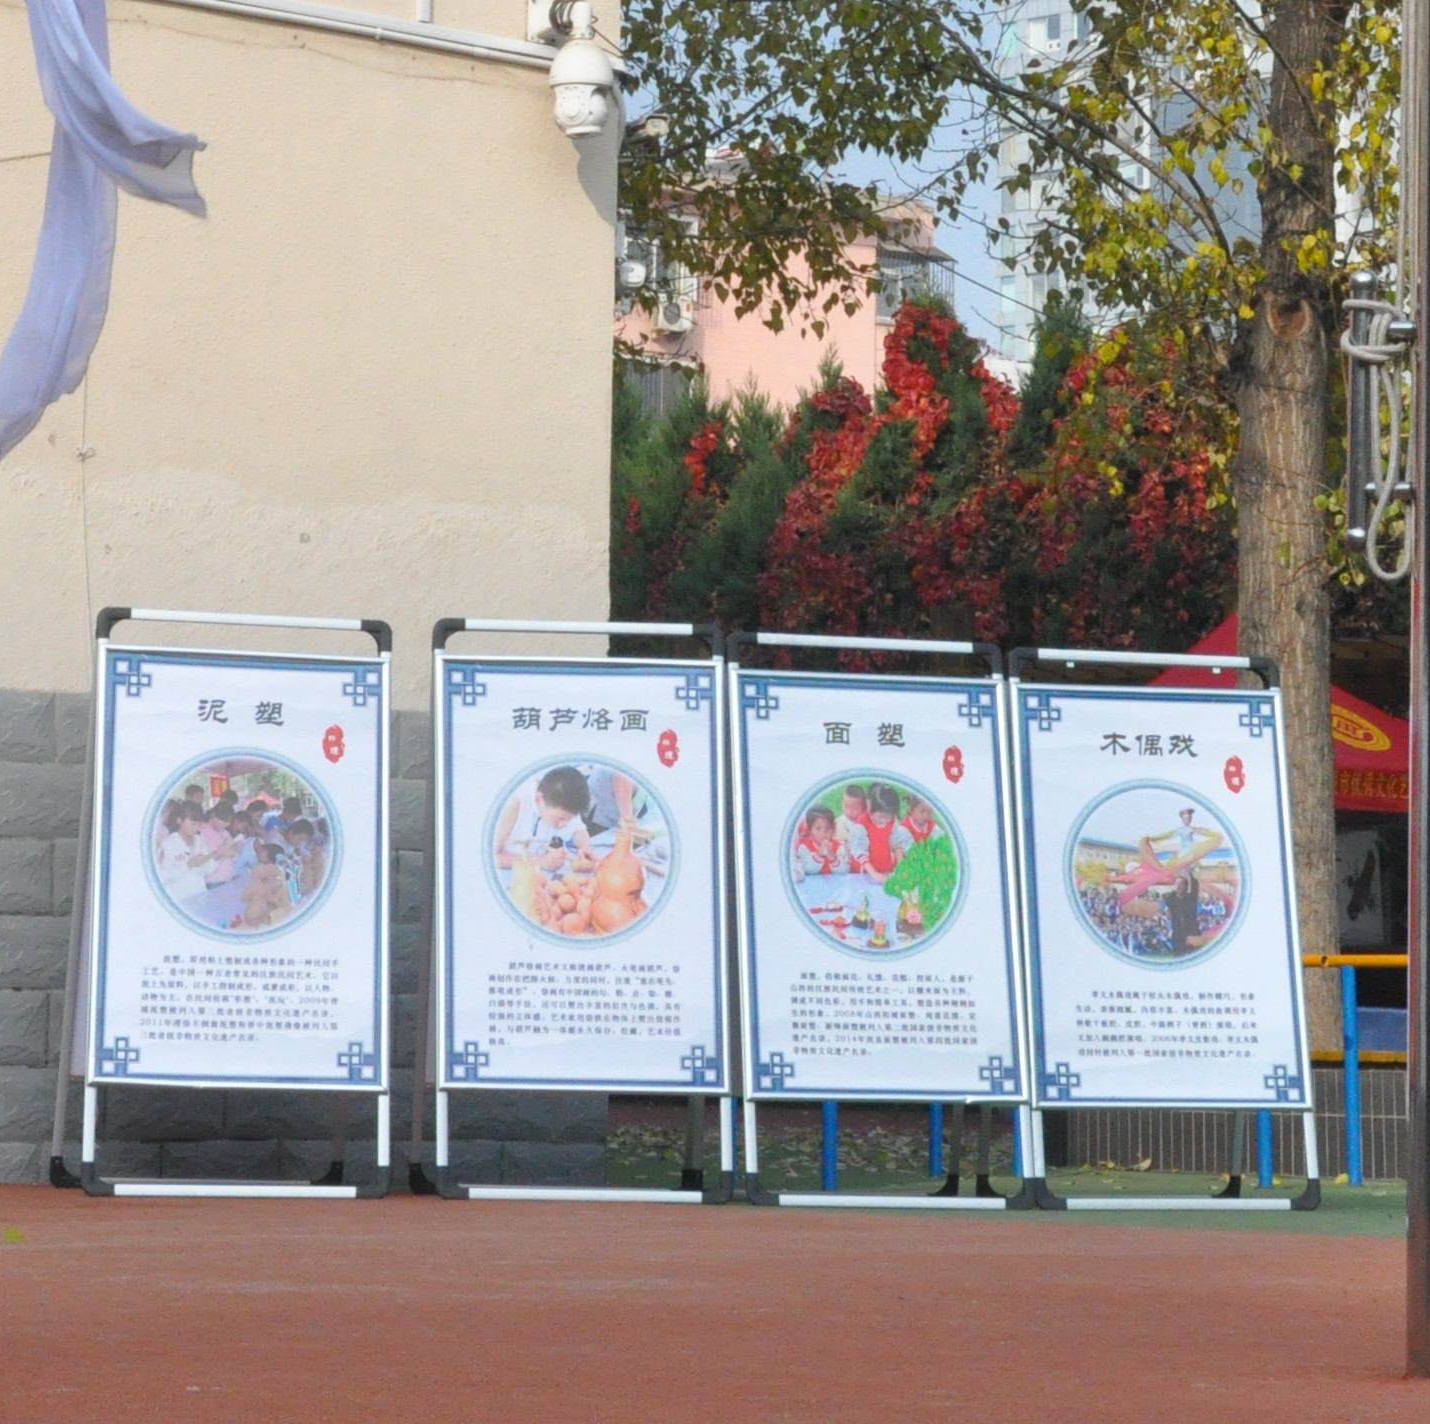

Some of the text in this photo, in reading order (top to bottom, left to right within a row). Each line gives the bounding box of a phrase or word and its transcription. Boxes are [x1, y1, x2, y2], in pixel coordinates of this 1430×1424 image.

[196, 698, 285, 727] 泥塑
[511, 706, 650, 732] 葫芦烙画
[823, 722, 906, 748] 面塑
[1100, 732, 1199, 758] 木偶戏
